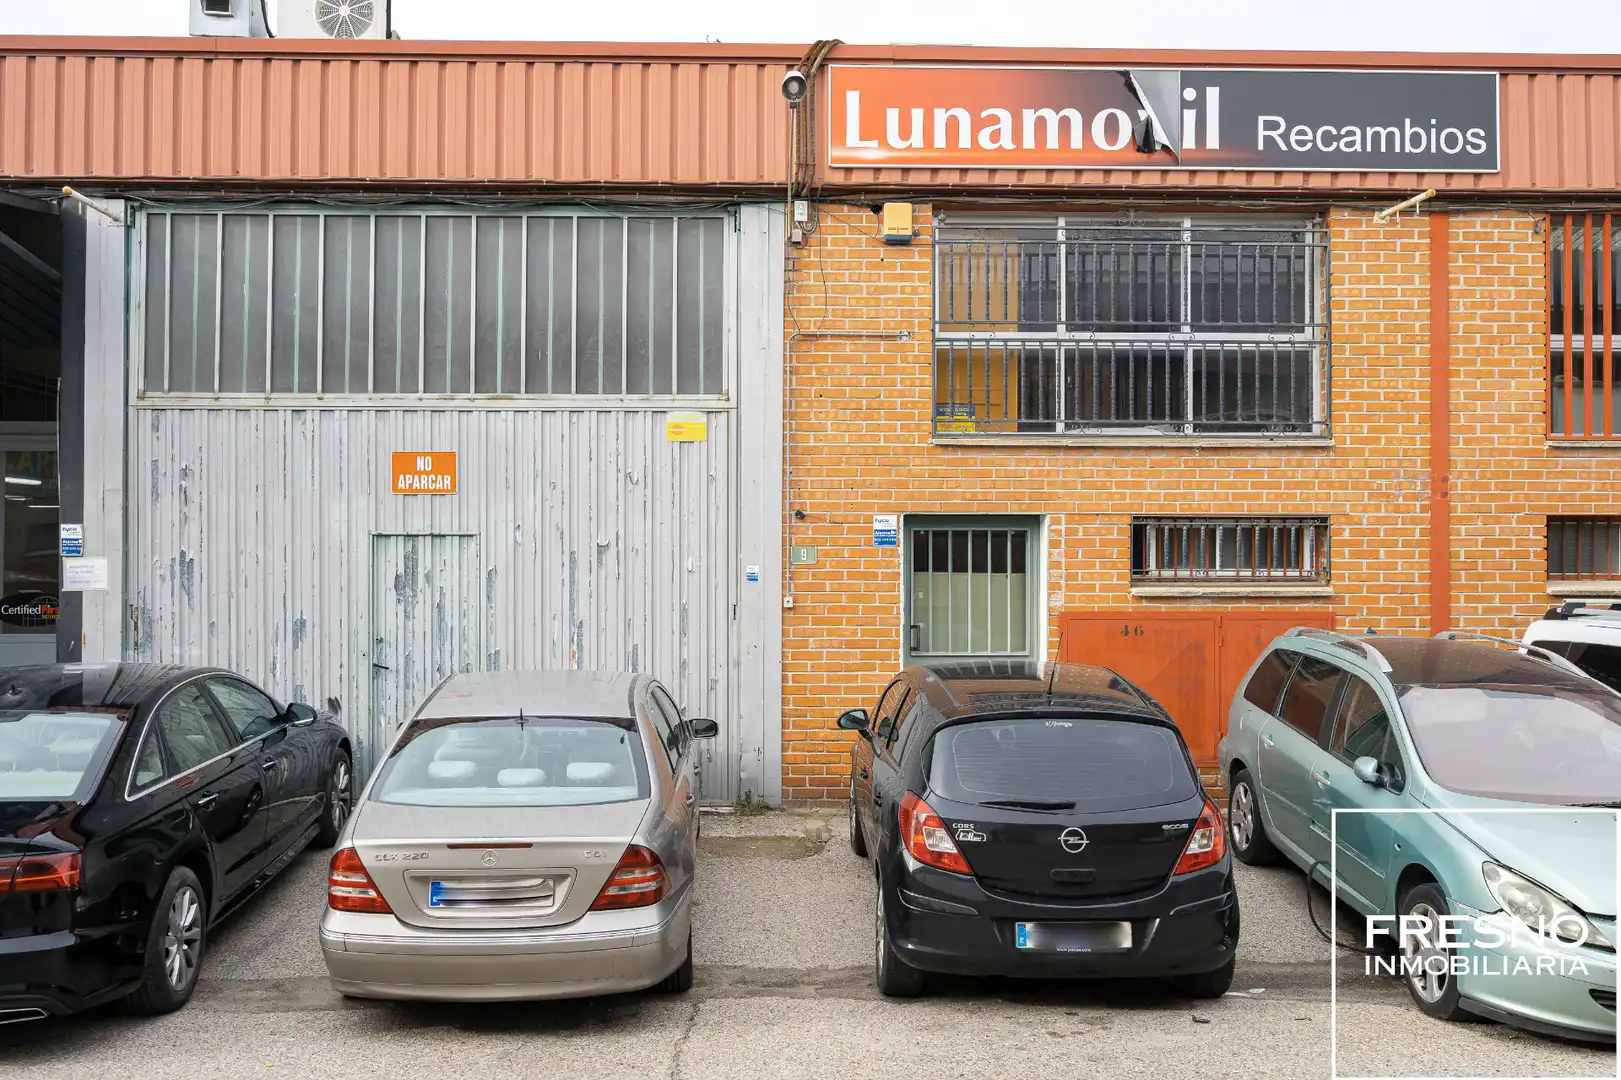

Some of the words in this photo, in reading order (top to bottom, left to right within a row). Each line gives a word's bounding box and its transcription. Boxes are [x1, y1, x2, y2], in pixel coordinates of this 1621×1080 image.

[1257, 115, 1487, 155] Recambios
[416, 455, 432, 471] NO
[397, 474, 451, 490] APARCAR
[800, 548, 807, 561] 9
[402, 852, 429, 861] 220
